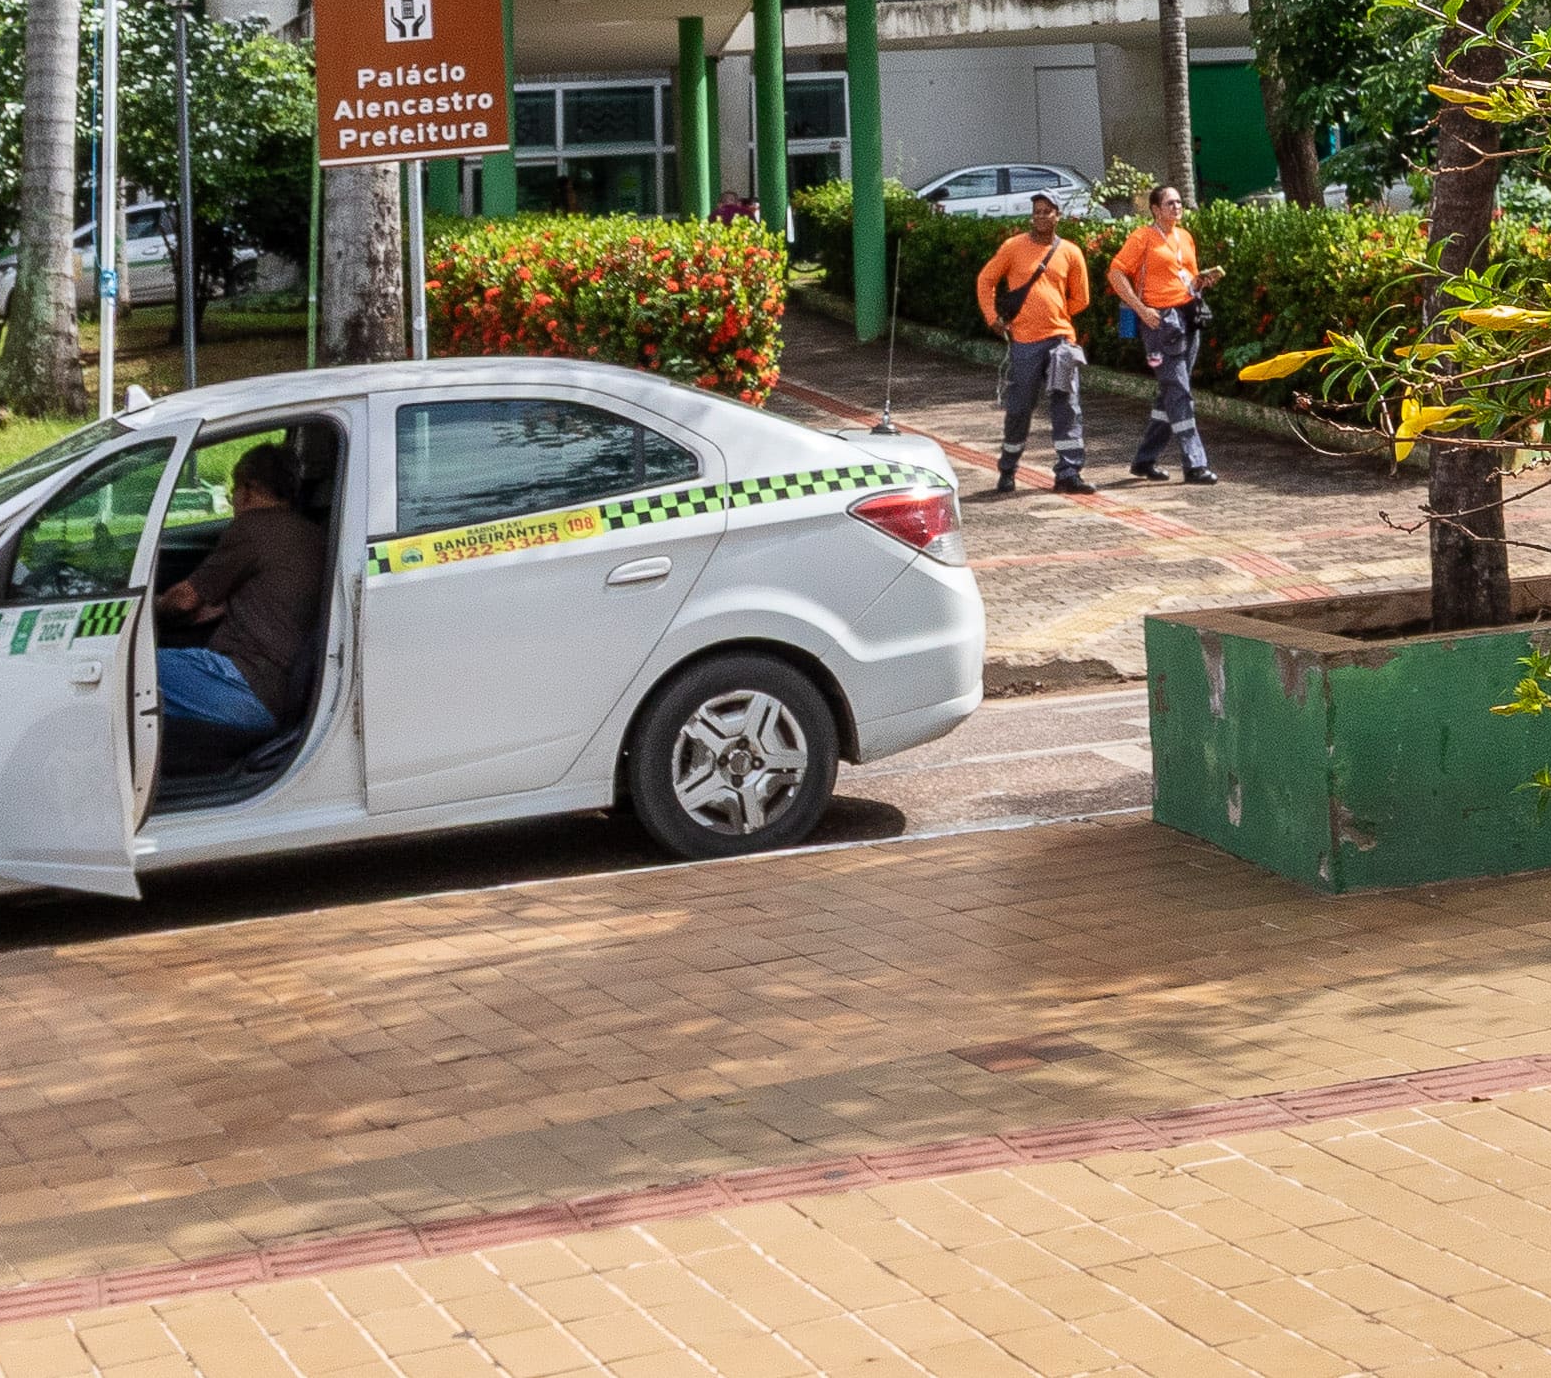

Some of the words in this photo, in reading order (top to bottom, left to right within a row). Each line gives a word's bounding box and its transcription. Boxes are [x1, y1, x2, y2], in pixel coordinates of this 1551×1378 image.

[357, 63, 466, 89] Palácio
[334, 92, 493, 121] Alencastro
[339, 121, 488, 150] Prefeitura
[433, 522, 558, 552] BANDEIRANTES
[567, 516, 594, 533] 198
[437, 531, 560, 564] 3322-3344
